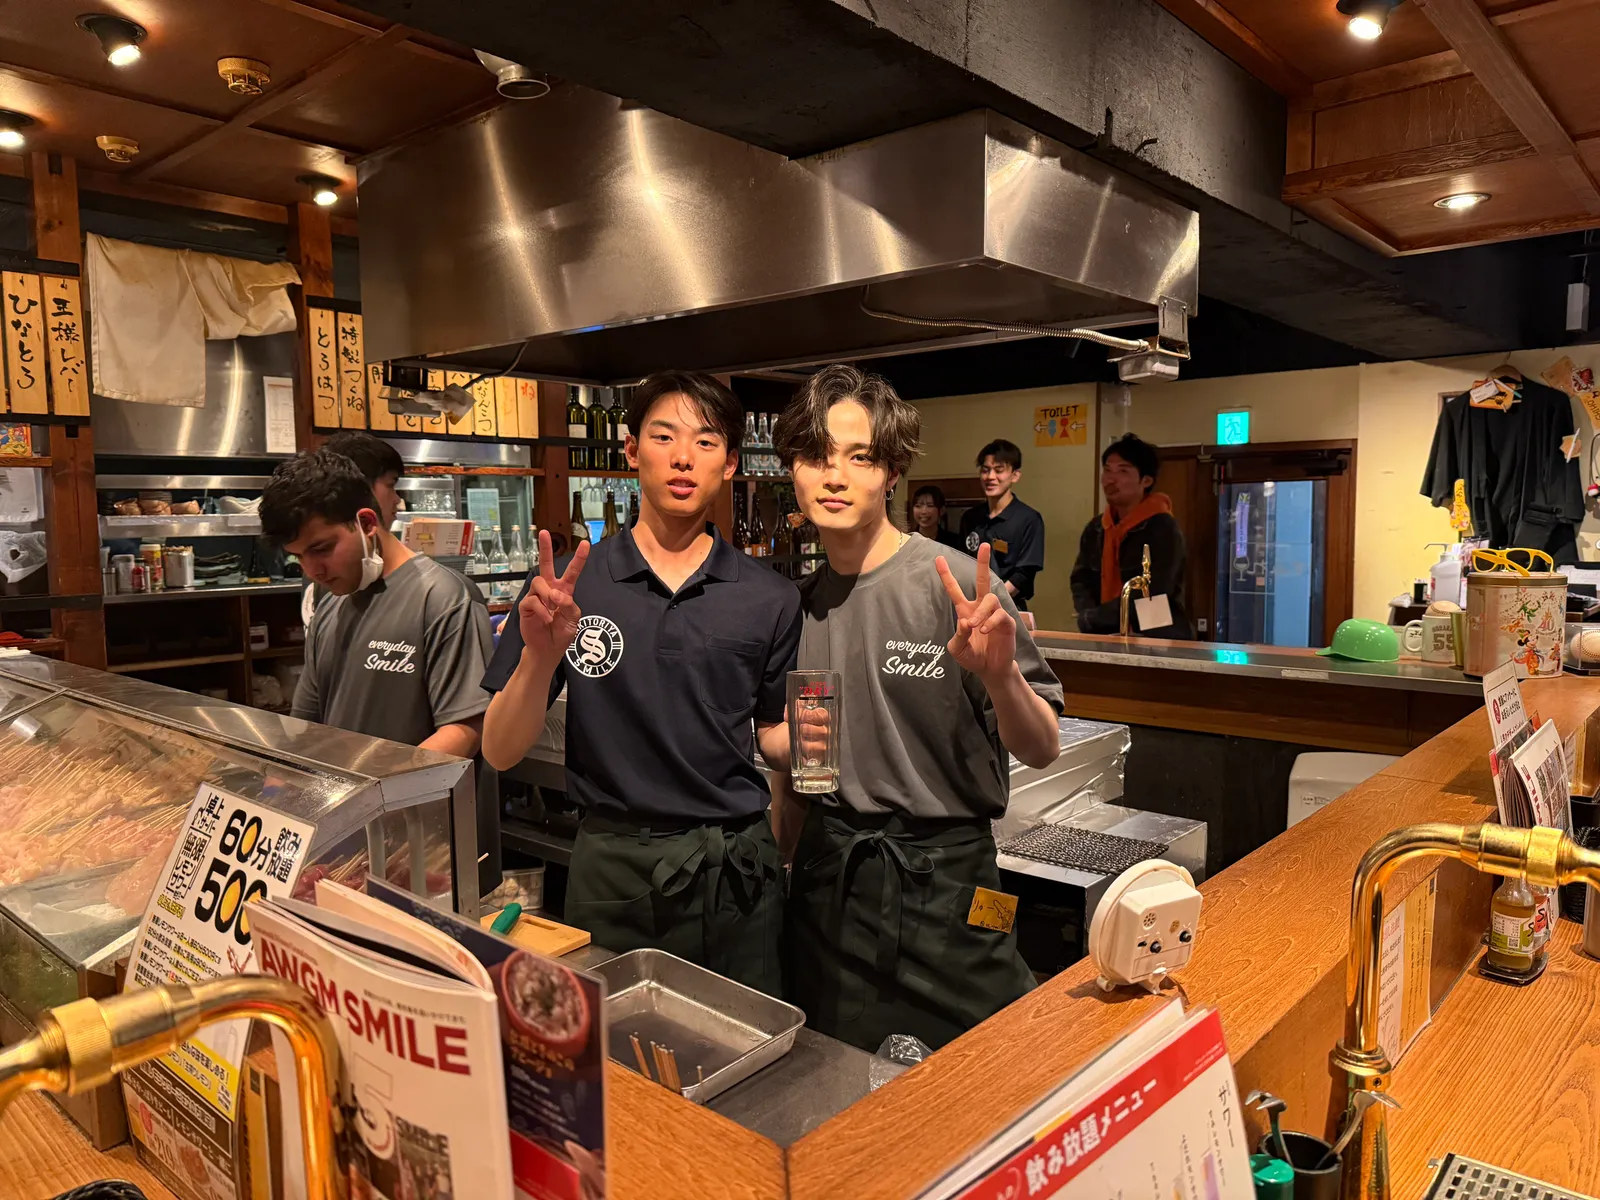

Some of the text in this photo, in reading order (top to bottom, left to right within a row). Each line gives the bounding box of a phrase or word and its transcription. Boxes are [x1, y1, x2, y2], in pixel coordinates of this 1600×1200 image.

[8, 293, 38, 389] ひなとろ
[51, 297, 84, 393] 王様レバー
[318, 327, 335, 410] とろはつ
[341, 327, 365, 412] 特製つくね
[1040, 405, 1079, 420] TOILET
[364, 653, 415, 674] Smile
[368, 640, 416, 658] everyday
[573, 657, 616, 676] SMILE
[580, 625, 606, 664] S
[881, 656, 945, 679] Smile
[885, 640, 945, 660] everyday
[260, 937, 342, 1017] AWGM
[343, 988, 472, 1076] SMILE
[1025, 1078, 1158, 1197] 飲み放題メニュー
[1218, 1085, 1235, 1148] サワー
